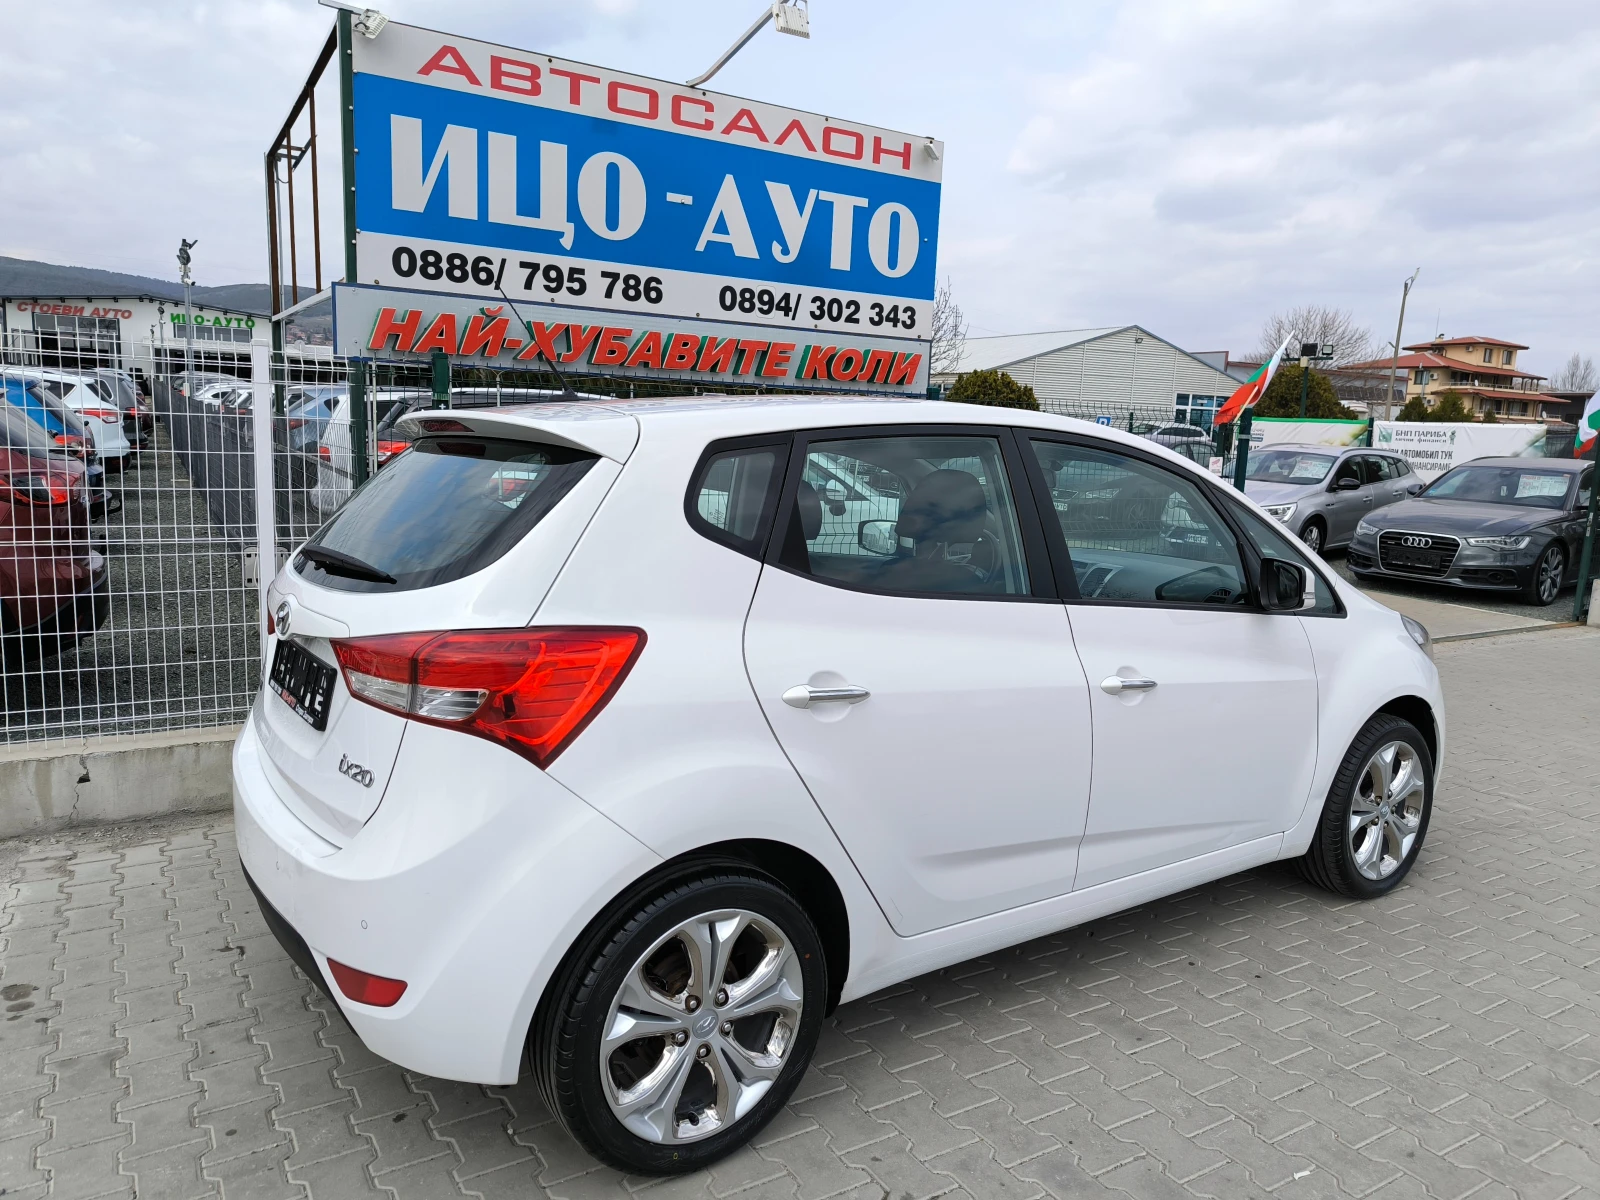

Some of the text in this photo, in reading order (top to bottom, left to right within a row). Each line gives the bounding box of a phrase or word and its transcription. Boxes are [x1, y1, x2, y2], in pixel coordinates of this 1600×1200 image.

[417, 45, 911, 170] АВТОСАЛОН
[391, 246, 664, 304] 0886/ 795 786
[17, 301, 132, 319] СТОЕВИ АУТО
[718, 285, 917, 329] 0894/ 302 343
[367, 305, 922, 385] НАЙ-ХУБАВИТЕ КОЛИ
[1414, 430, 1447, 438] ПАРИБА
[1440, 450, 1453, 460] ТУК
[338, 753, 375, 788] ix20
